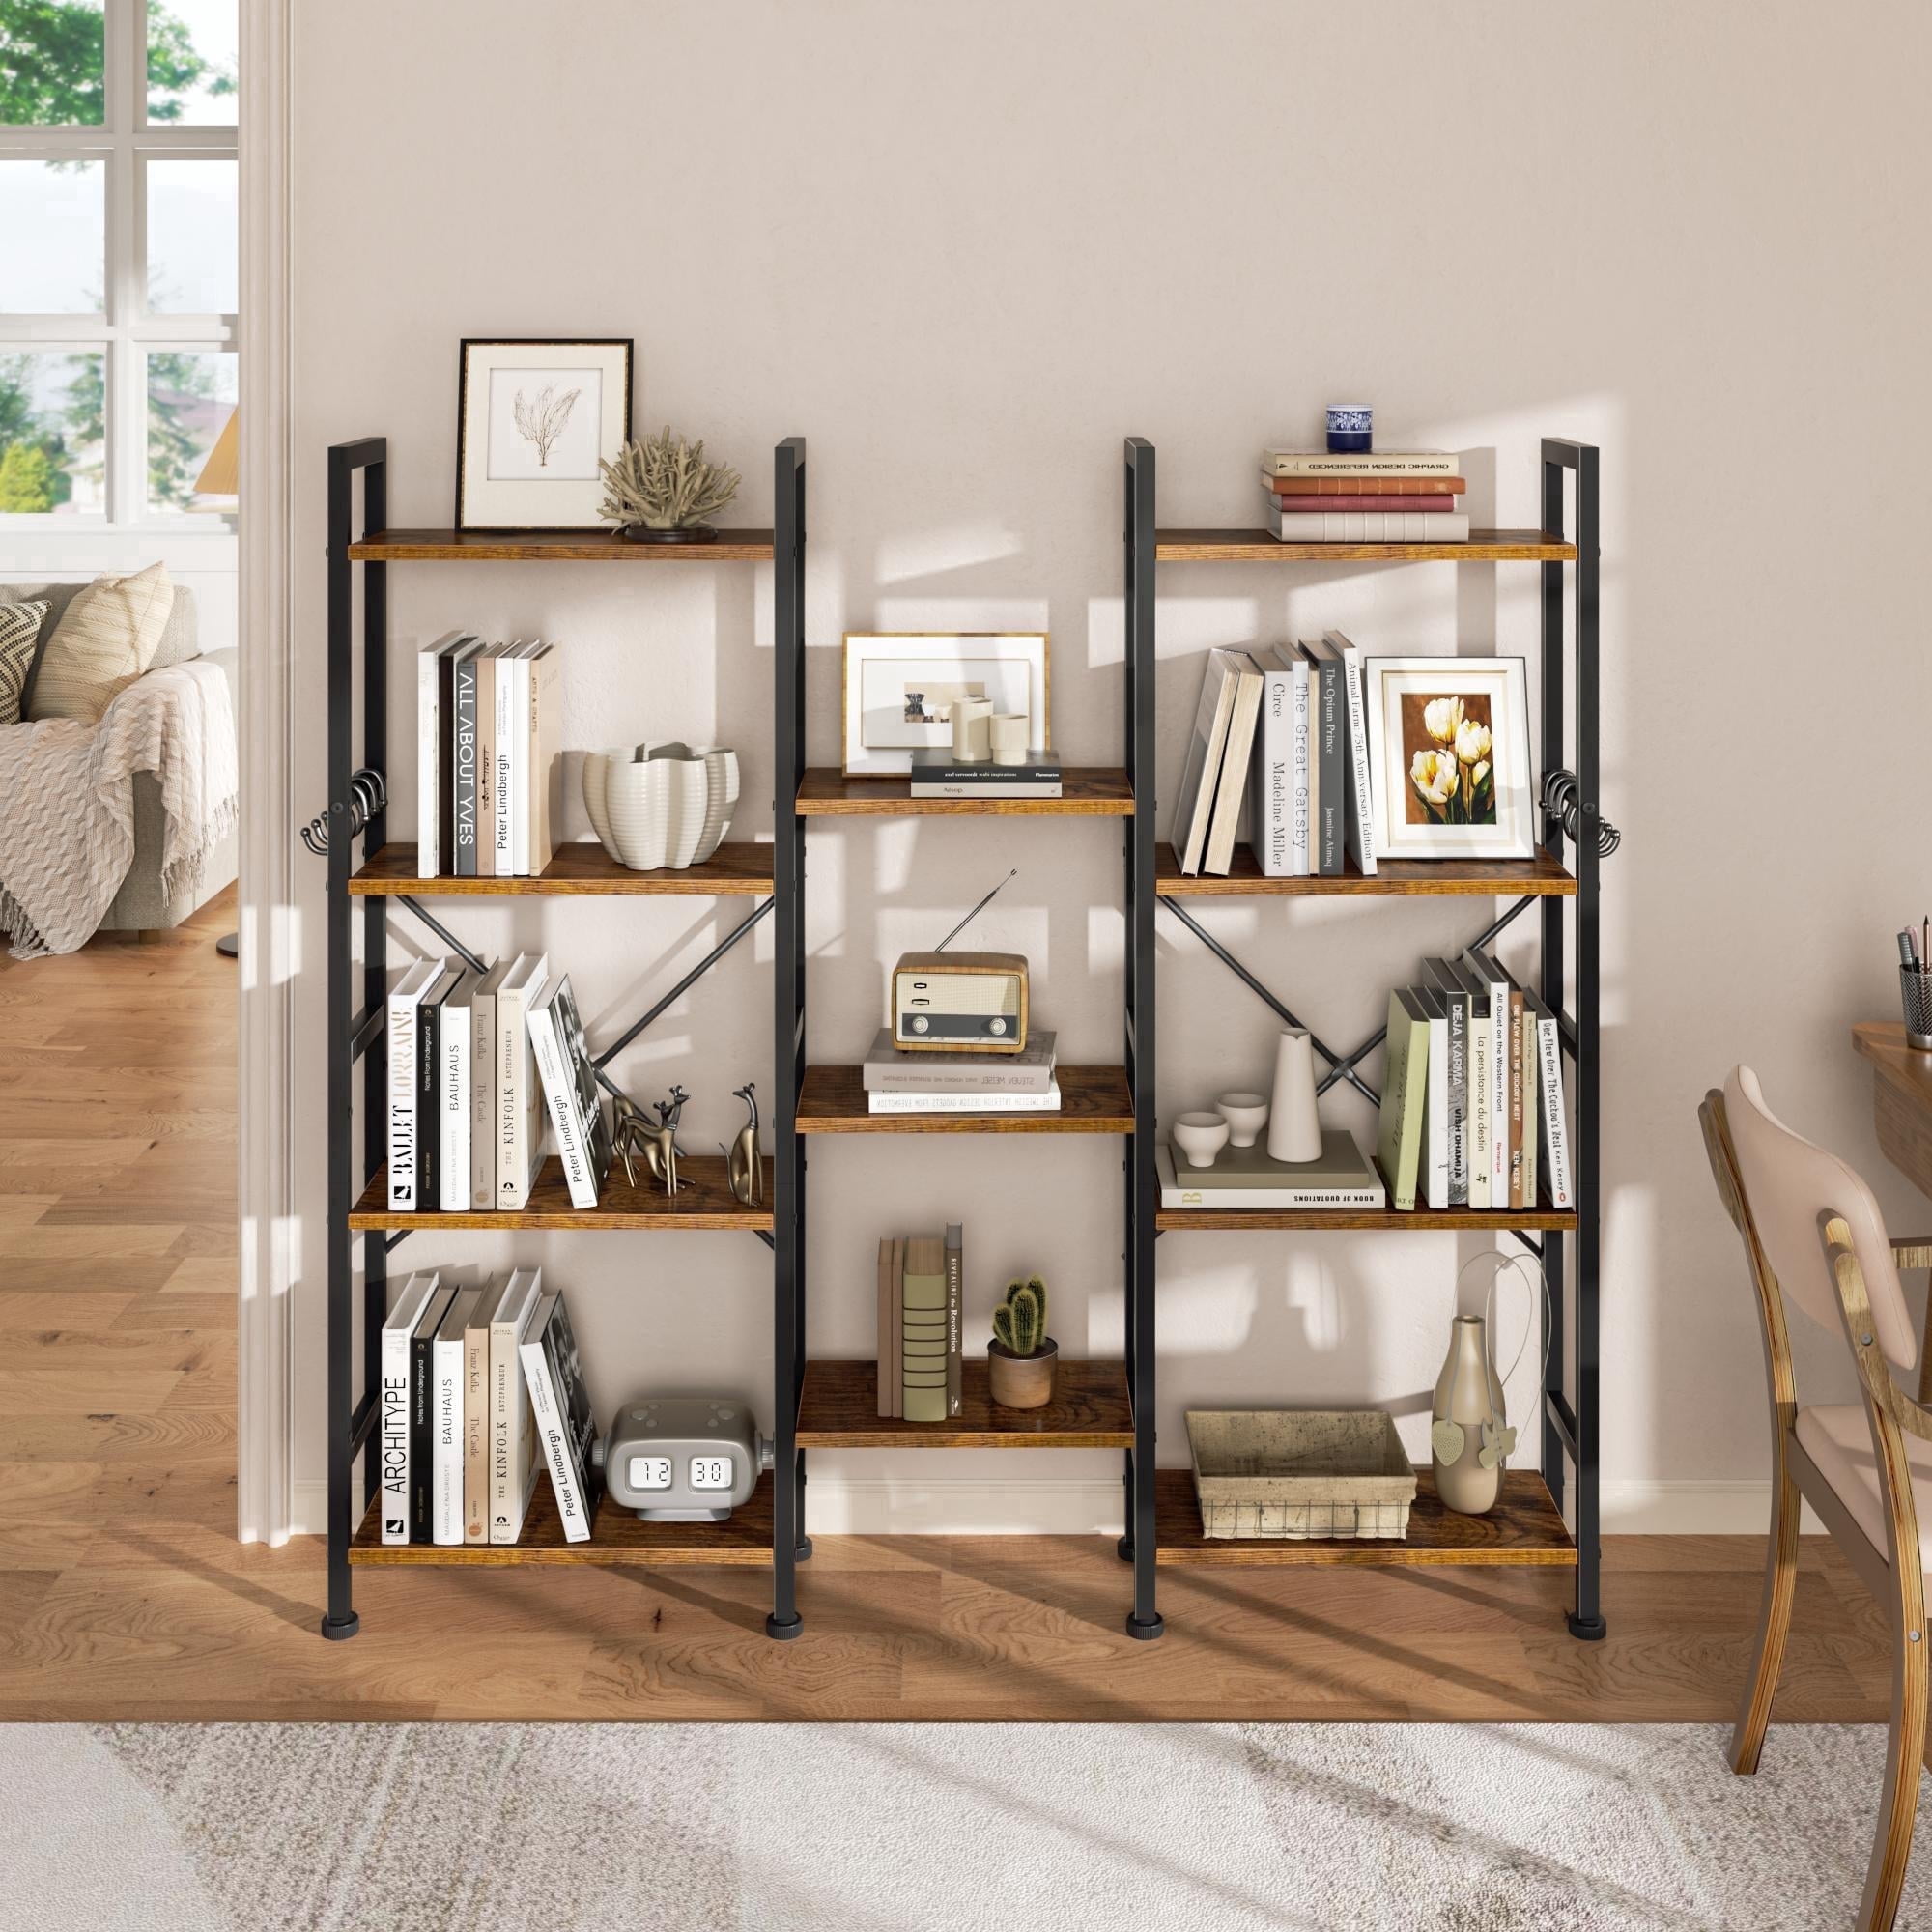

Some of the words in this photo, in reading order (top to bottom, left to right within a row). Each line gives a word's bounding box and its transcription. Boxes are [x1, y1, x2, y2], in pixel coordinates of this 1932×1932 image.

[459, 672, 474, 709] ALL
[1326, 669, 1336, 686] The
[1349, 663, 1359, 698] Animal
[1273, 683, 1285, 717] Circe
[1295, 683, 1309, 713] The
[1324, 688, 1336, 722] Opium
[1351, 702, 1361, 731] Farm:
[459, 716, 474, 787] ABOUT
[1295, 724, 1308, 775] Great
[1326, 724, 1336, 754] Prince
[1355, 733, 1365, 754] 75th
[497, 754, 510, 815] Lindbergh
[1273, 762, 1285, 822] Madeline
[1356, 757, 1368, 819] Anniversary
[459, 795, 474, 845] YVES
[1293, 787, 1309, 849] Gatsby
[1324, 807, 1334, 838] Jasmine
[497, 819, 507, 849] Peter
[1273, 827, 1285, 867] Miller
[1362, 822, 1372, 859] Edition
[1324, 840, 1334, 867] Aimaq
[477, 1013, 487, 1035] Franz
[1496, 1029, 1502, 1040] on
[1544, 1022, 1552, 1037] One
[477, 1037, 487, 1060] Kafka
[1477, 1037, 1487, 1047] La
[1545, 1039, 1553, 1056] Flew
[449, 1044, 459, 1111] BAUHAUS
[1452, 1040, 1463, 1086] KARMA
[1476, 1050, 1487, 1105] persistance
[477, 1082, 487, 1098] The
[1548, 1078, 1557, 1094] The
[477, 1100, 487, 1123] Castle
[503, 1087, 514, 1144] KINFOLK
[554, 1095, 575, 1156] Lindbergh
[1477, 1107, 1488, 1120] du
[1548, 1094, 1560, 1128] Cuckoo's
[392, 1104, 412, 1174] BALLET
[1477, 1123, 1487, 1151] destin
[1552, 1131, 1561, 1148] Nest
[568, 1155, 582, 1183] Peter
[470, 1348, 480, 1369] Franz
[470, 1371, 480, 1394] Kafka
[442, 1378, 453, 1445] BAUHAUS
[470, 1417, 480, 1434] The
[384, 1377, 406, 1493] ARCHITYPE
[470, 1435, 480, 1458] Castle
[497, 1421, 507, 1479] KINFOLK
[547, 1429, 568, 1485] Lindbergh
[644, 1463, 668, 1482] 12
[696, 1463, 721, 1482] 30
[561, 1486, 576, 1517] Peter
